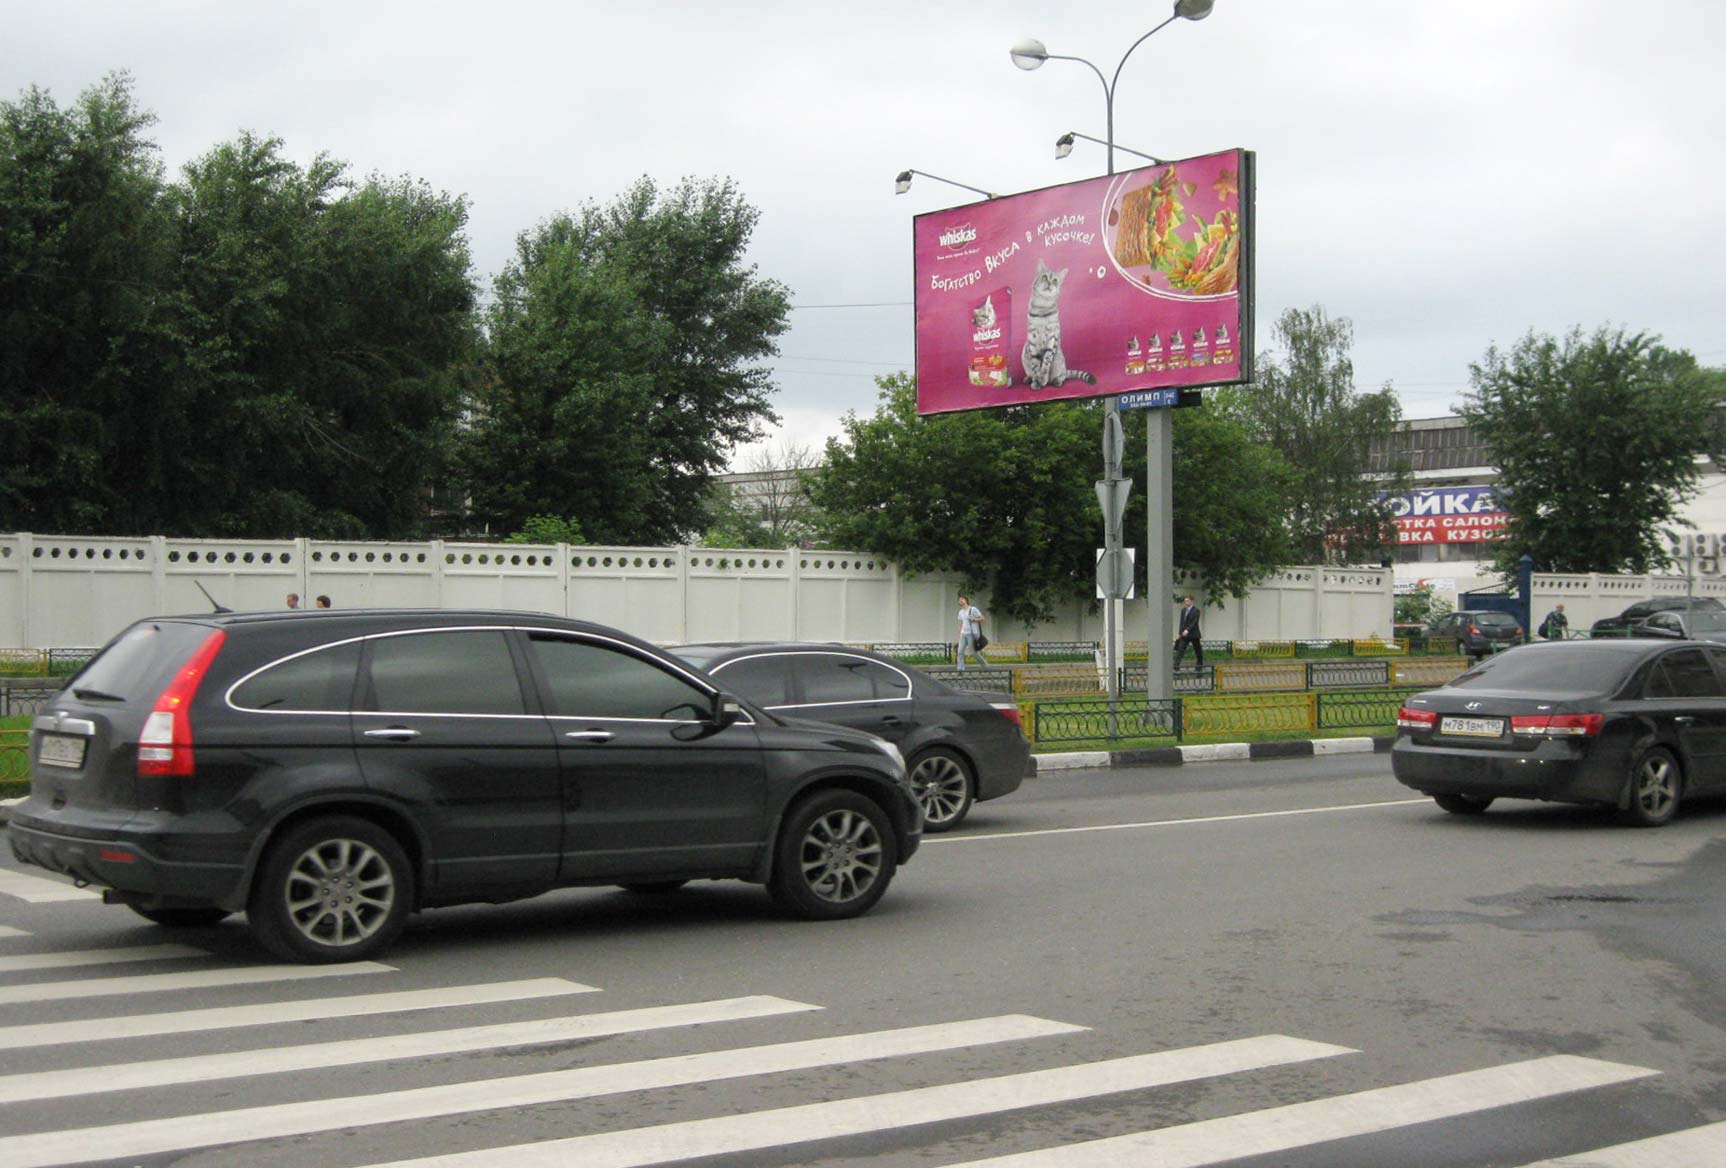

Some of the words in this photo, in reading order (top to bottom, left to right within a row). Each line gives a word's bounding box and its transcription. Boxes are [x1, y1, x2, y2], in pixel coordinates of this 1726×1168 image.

[939, 228, 977, 247] whiskas
[1121, 392, 1160, 404] ОЛИМП
[1366, 491, 1502, 517] ОЙКА
[1447, 529, 1513, 541] КУЗО
